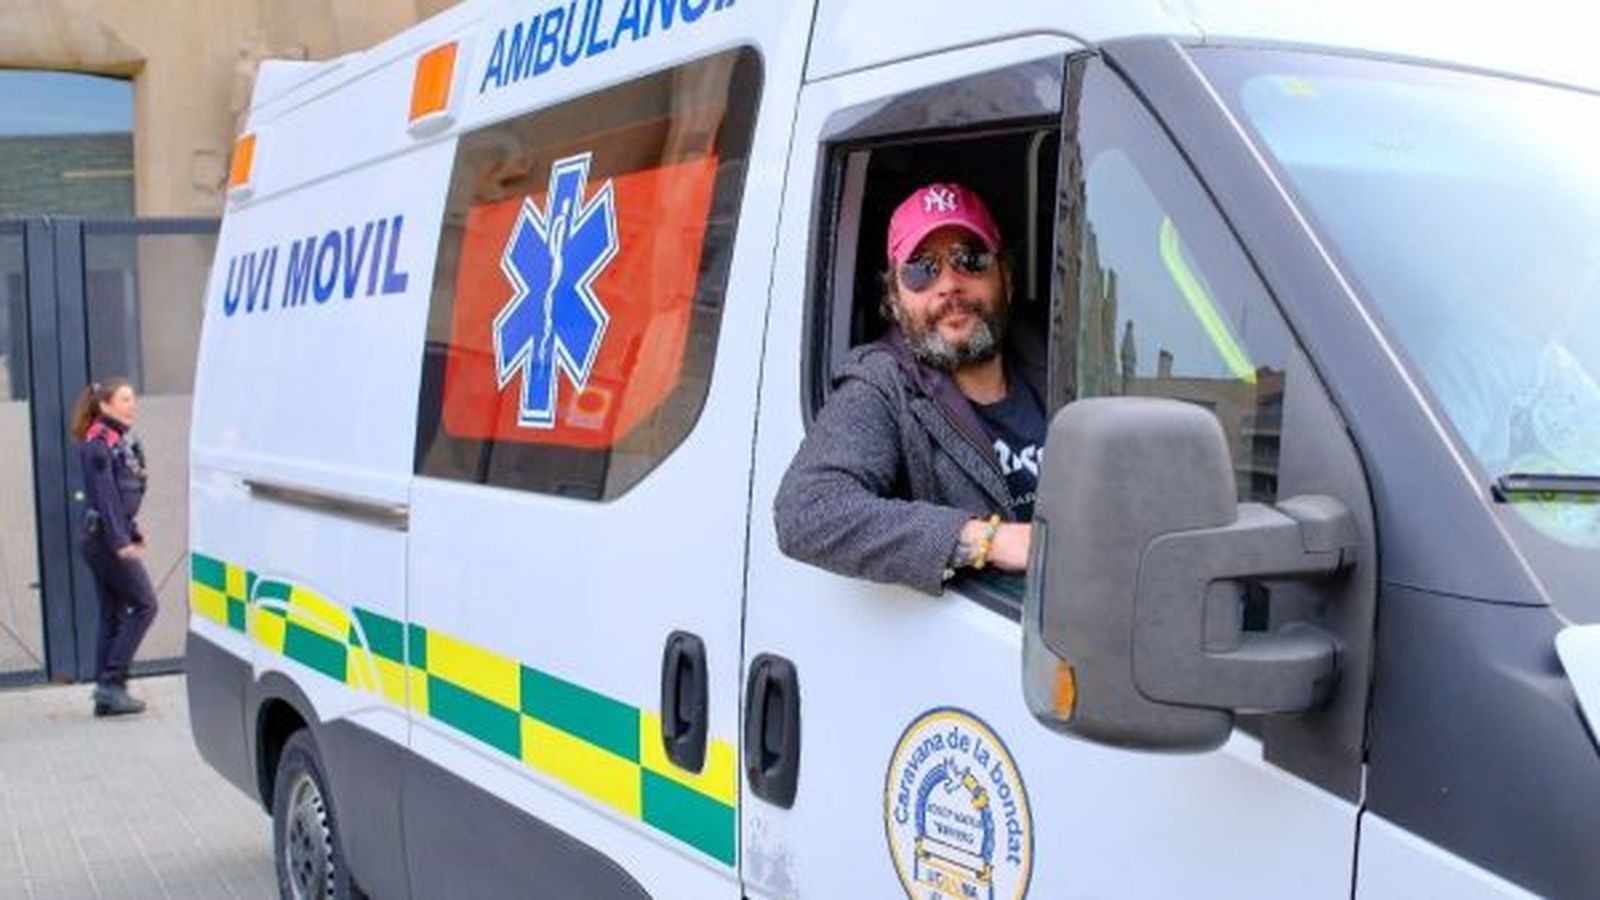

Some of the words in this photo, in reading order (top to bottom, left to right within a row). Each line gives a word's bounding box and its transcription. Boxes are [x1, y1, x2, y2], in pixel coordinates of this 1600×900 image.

[480, 0, 736, 93] AMBULAN
[224, 246, 278, 317] UVI
[282, 214, 409, 308] MOVIL
[895, 733, 945, 824] Caravana
[947, 726, 970, 752] de
[973, 738, 991, 768] la
[989, 761, 1023, 865] bondat
